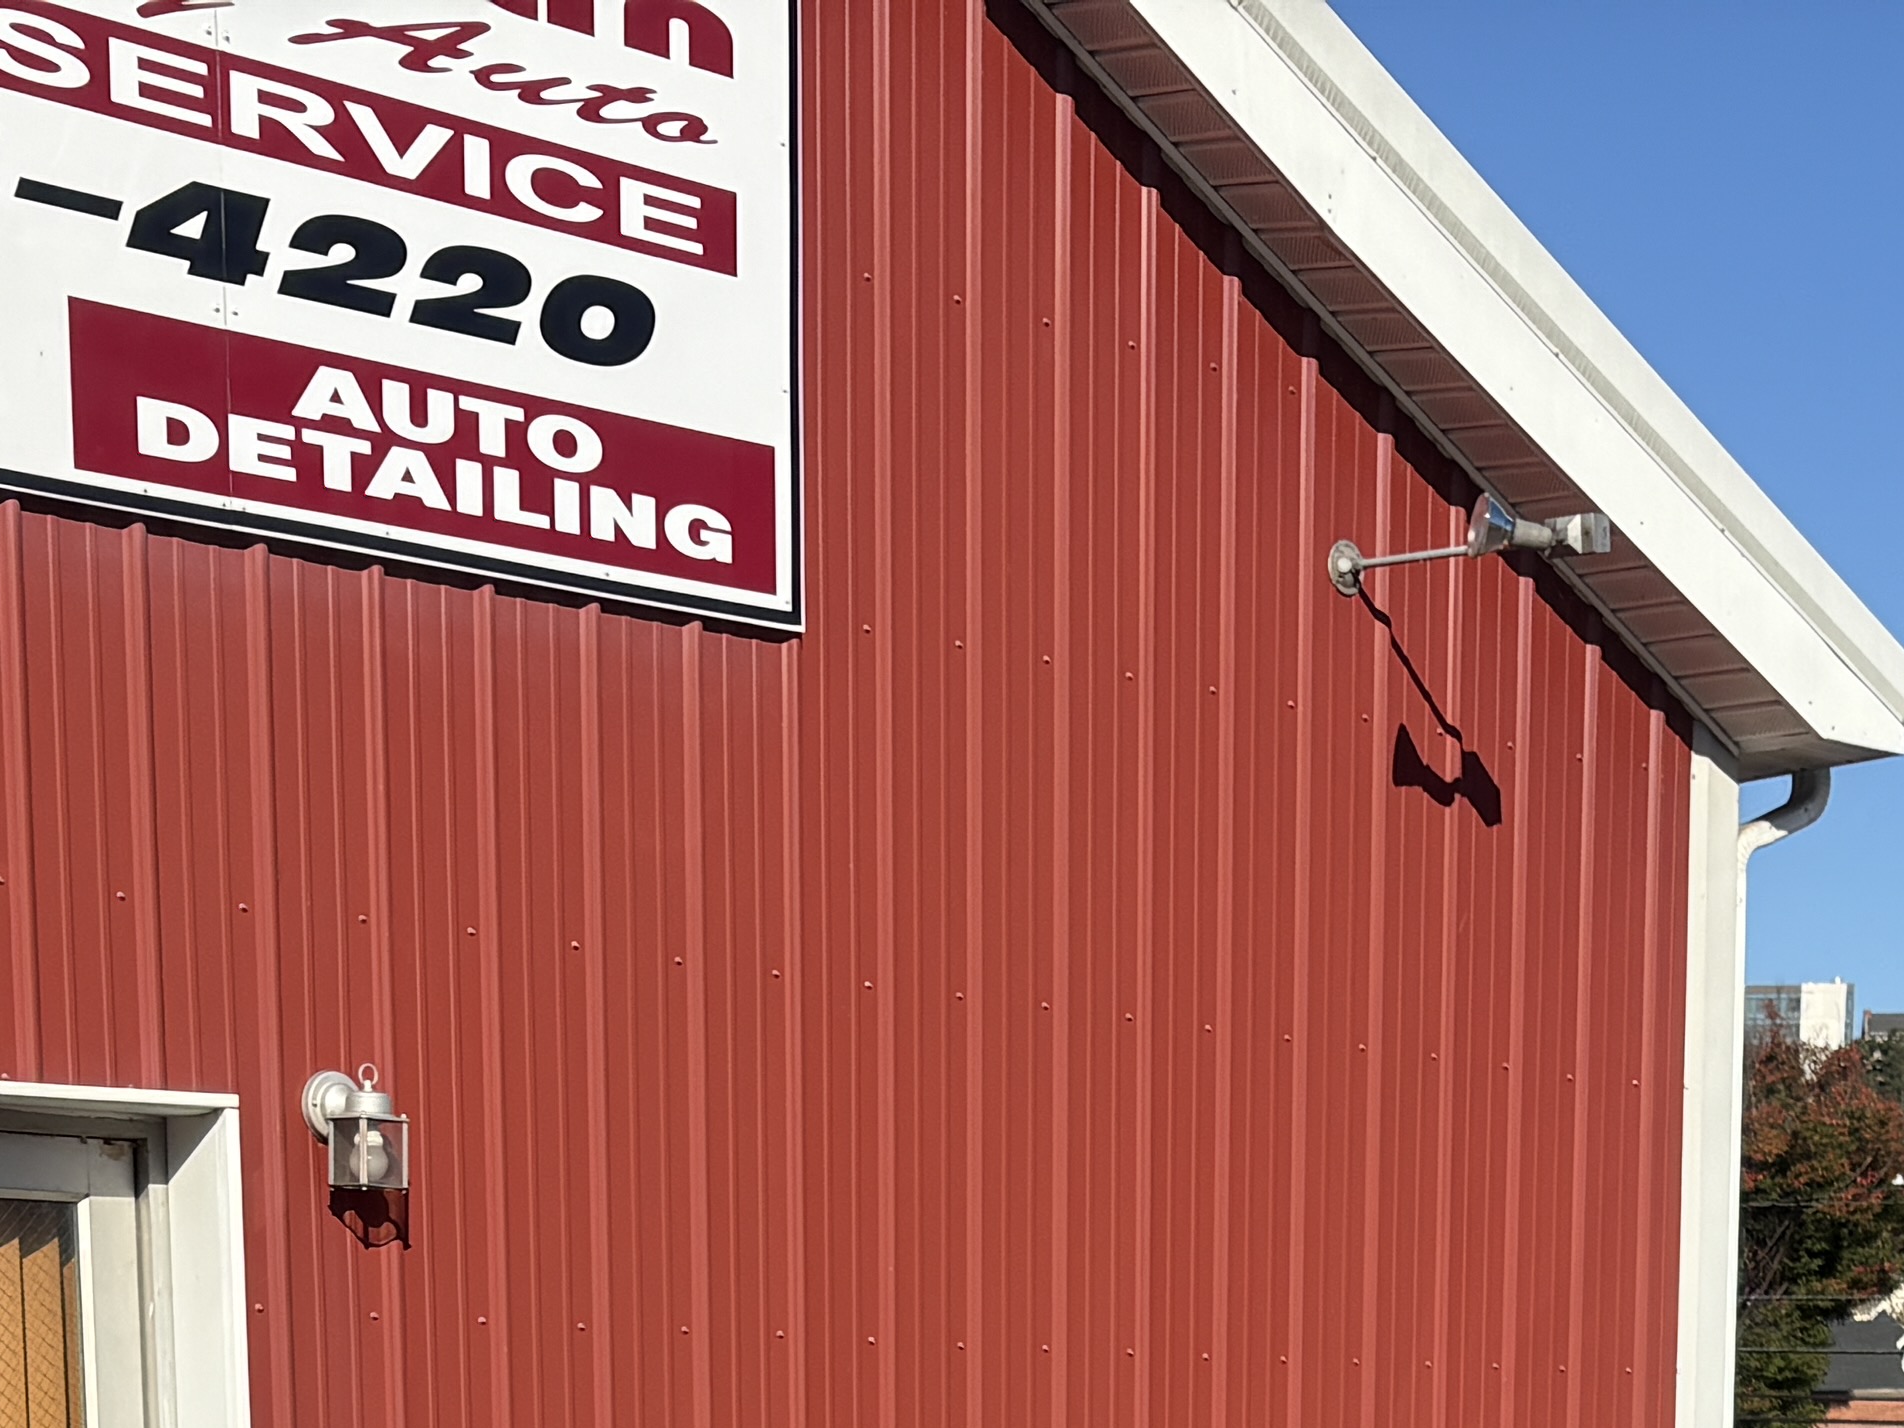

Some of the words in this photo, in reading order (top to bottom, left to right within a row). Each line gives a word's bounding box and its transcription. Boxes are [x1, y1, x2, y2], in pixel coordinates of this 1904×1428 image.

[287, 18, 718, 144] Auto
[135, 395, 733, 564] DETAILING
[291, 364, 604, 474] AUTO
